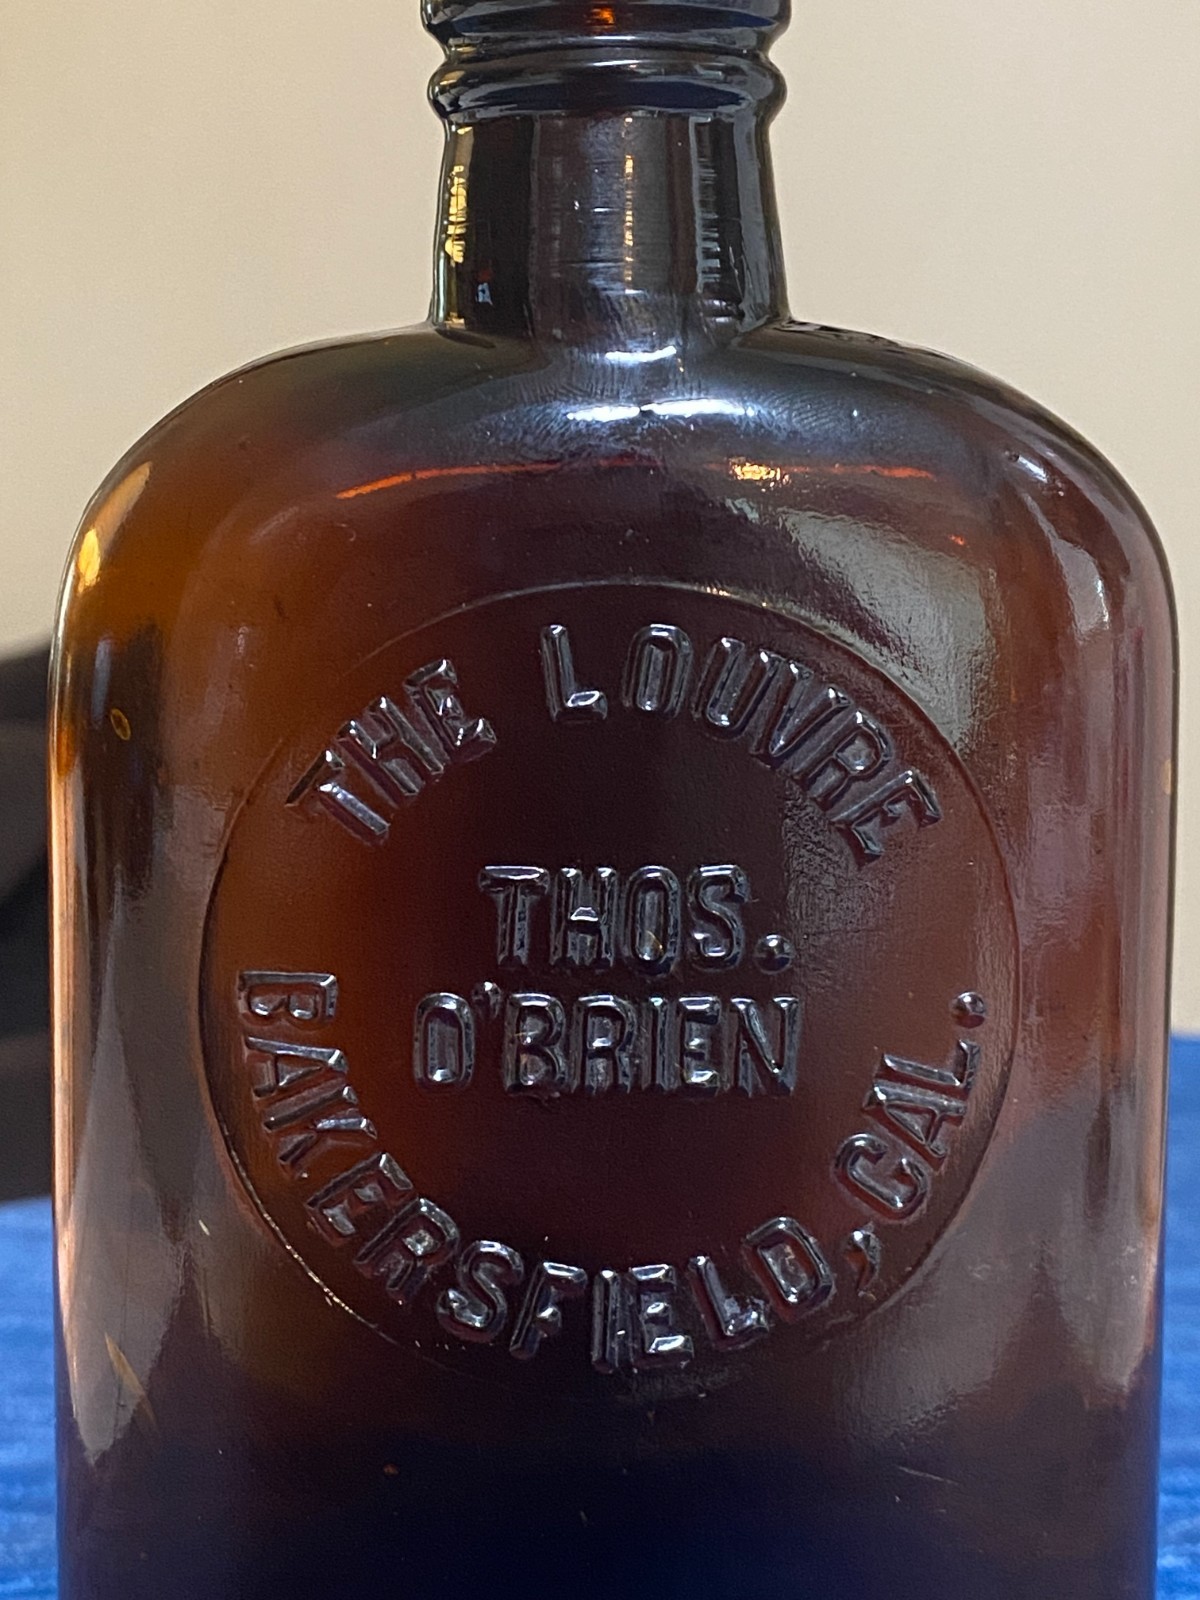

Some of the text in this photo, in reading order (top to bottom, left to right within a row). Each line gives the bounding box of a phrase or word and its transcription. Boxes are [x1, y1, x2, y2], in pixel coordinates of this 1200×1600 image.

[284, 621, 941, 868] THE LOUVRE
[478, 864, 796, 976] THOS.
[413, 981, 800, 1098] O'BRIEN
[236, 969, 987, 1374] BAKERSFIELD, CAL.
